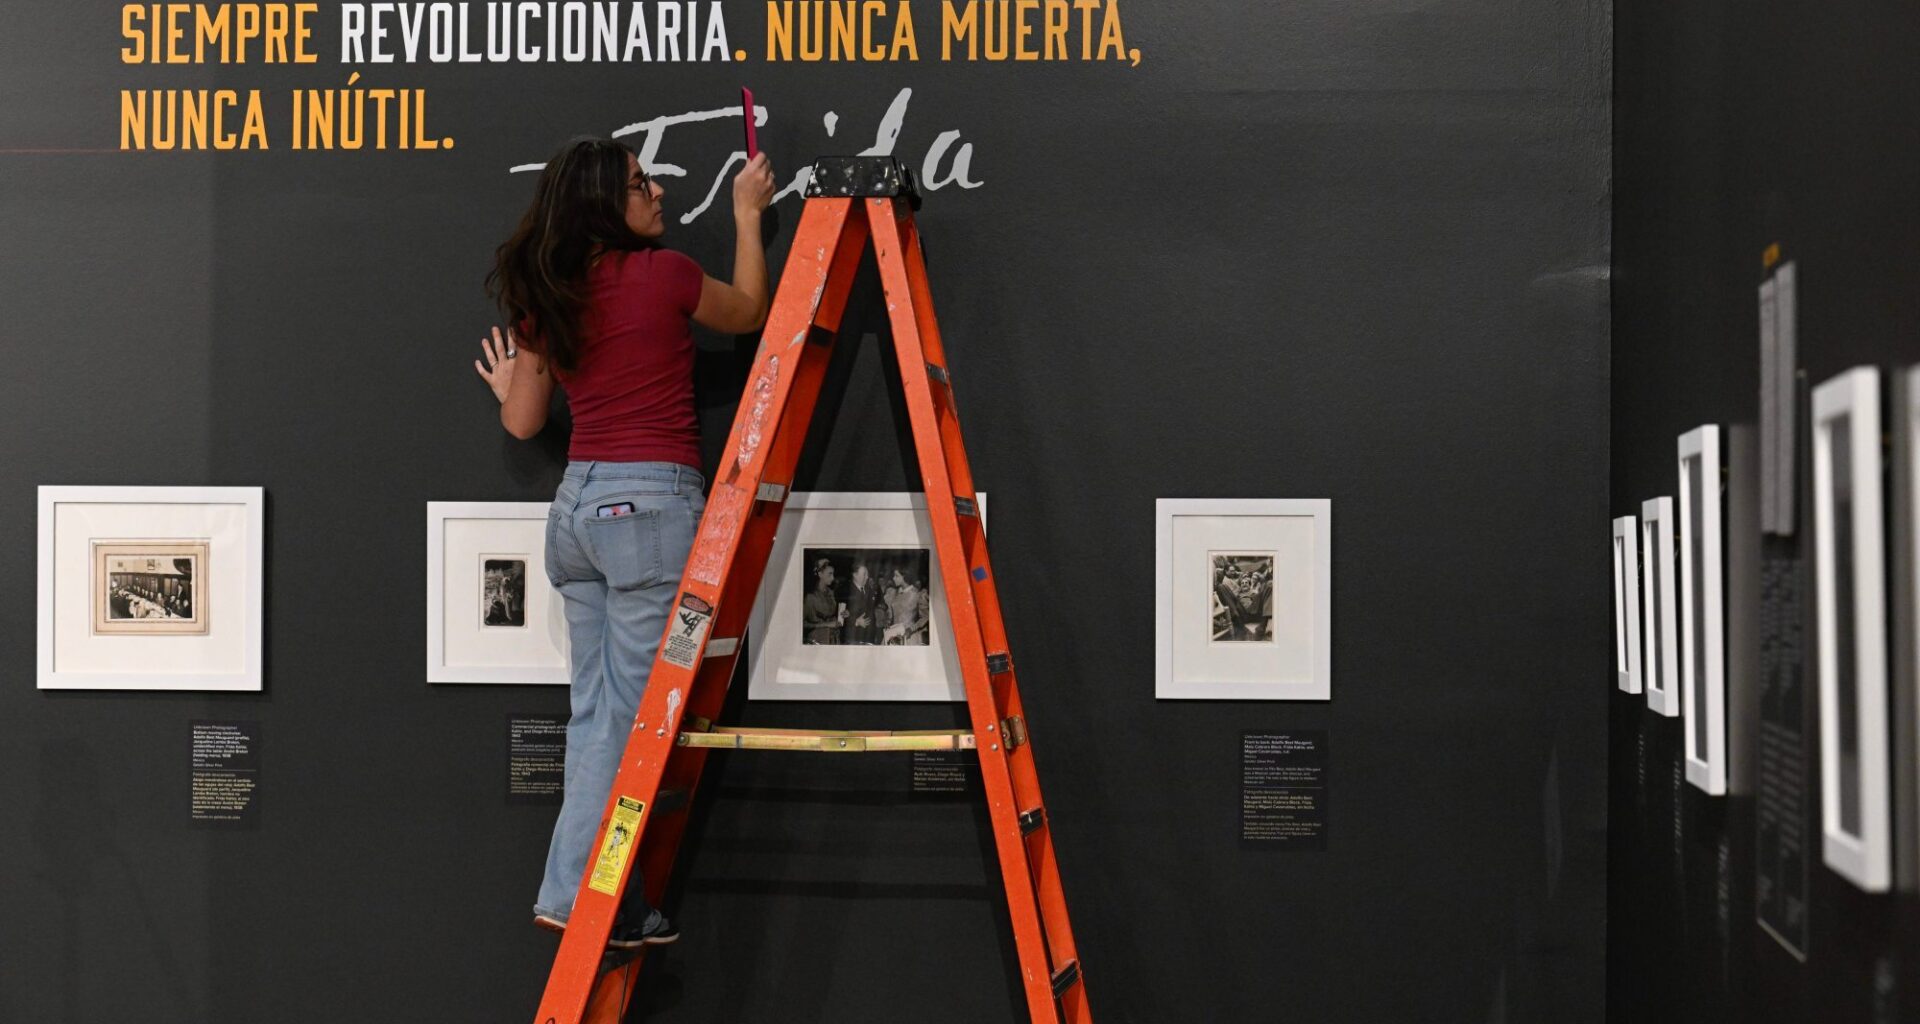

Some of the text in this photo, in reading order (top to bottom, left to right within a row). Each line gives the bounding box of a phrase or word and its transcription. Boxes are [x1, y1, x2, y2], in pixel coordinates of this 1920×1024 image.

[121, 0, 1141, 67] SIEMPRE REVOLUCIONARIA. NUNCA MUERTA,
[120, 71, 454, 150] NUNCA INÚTIL.
